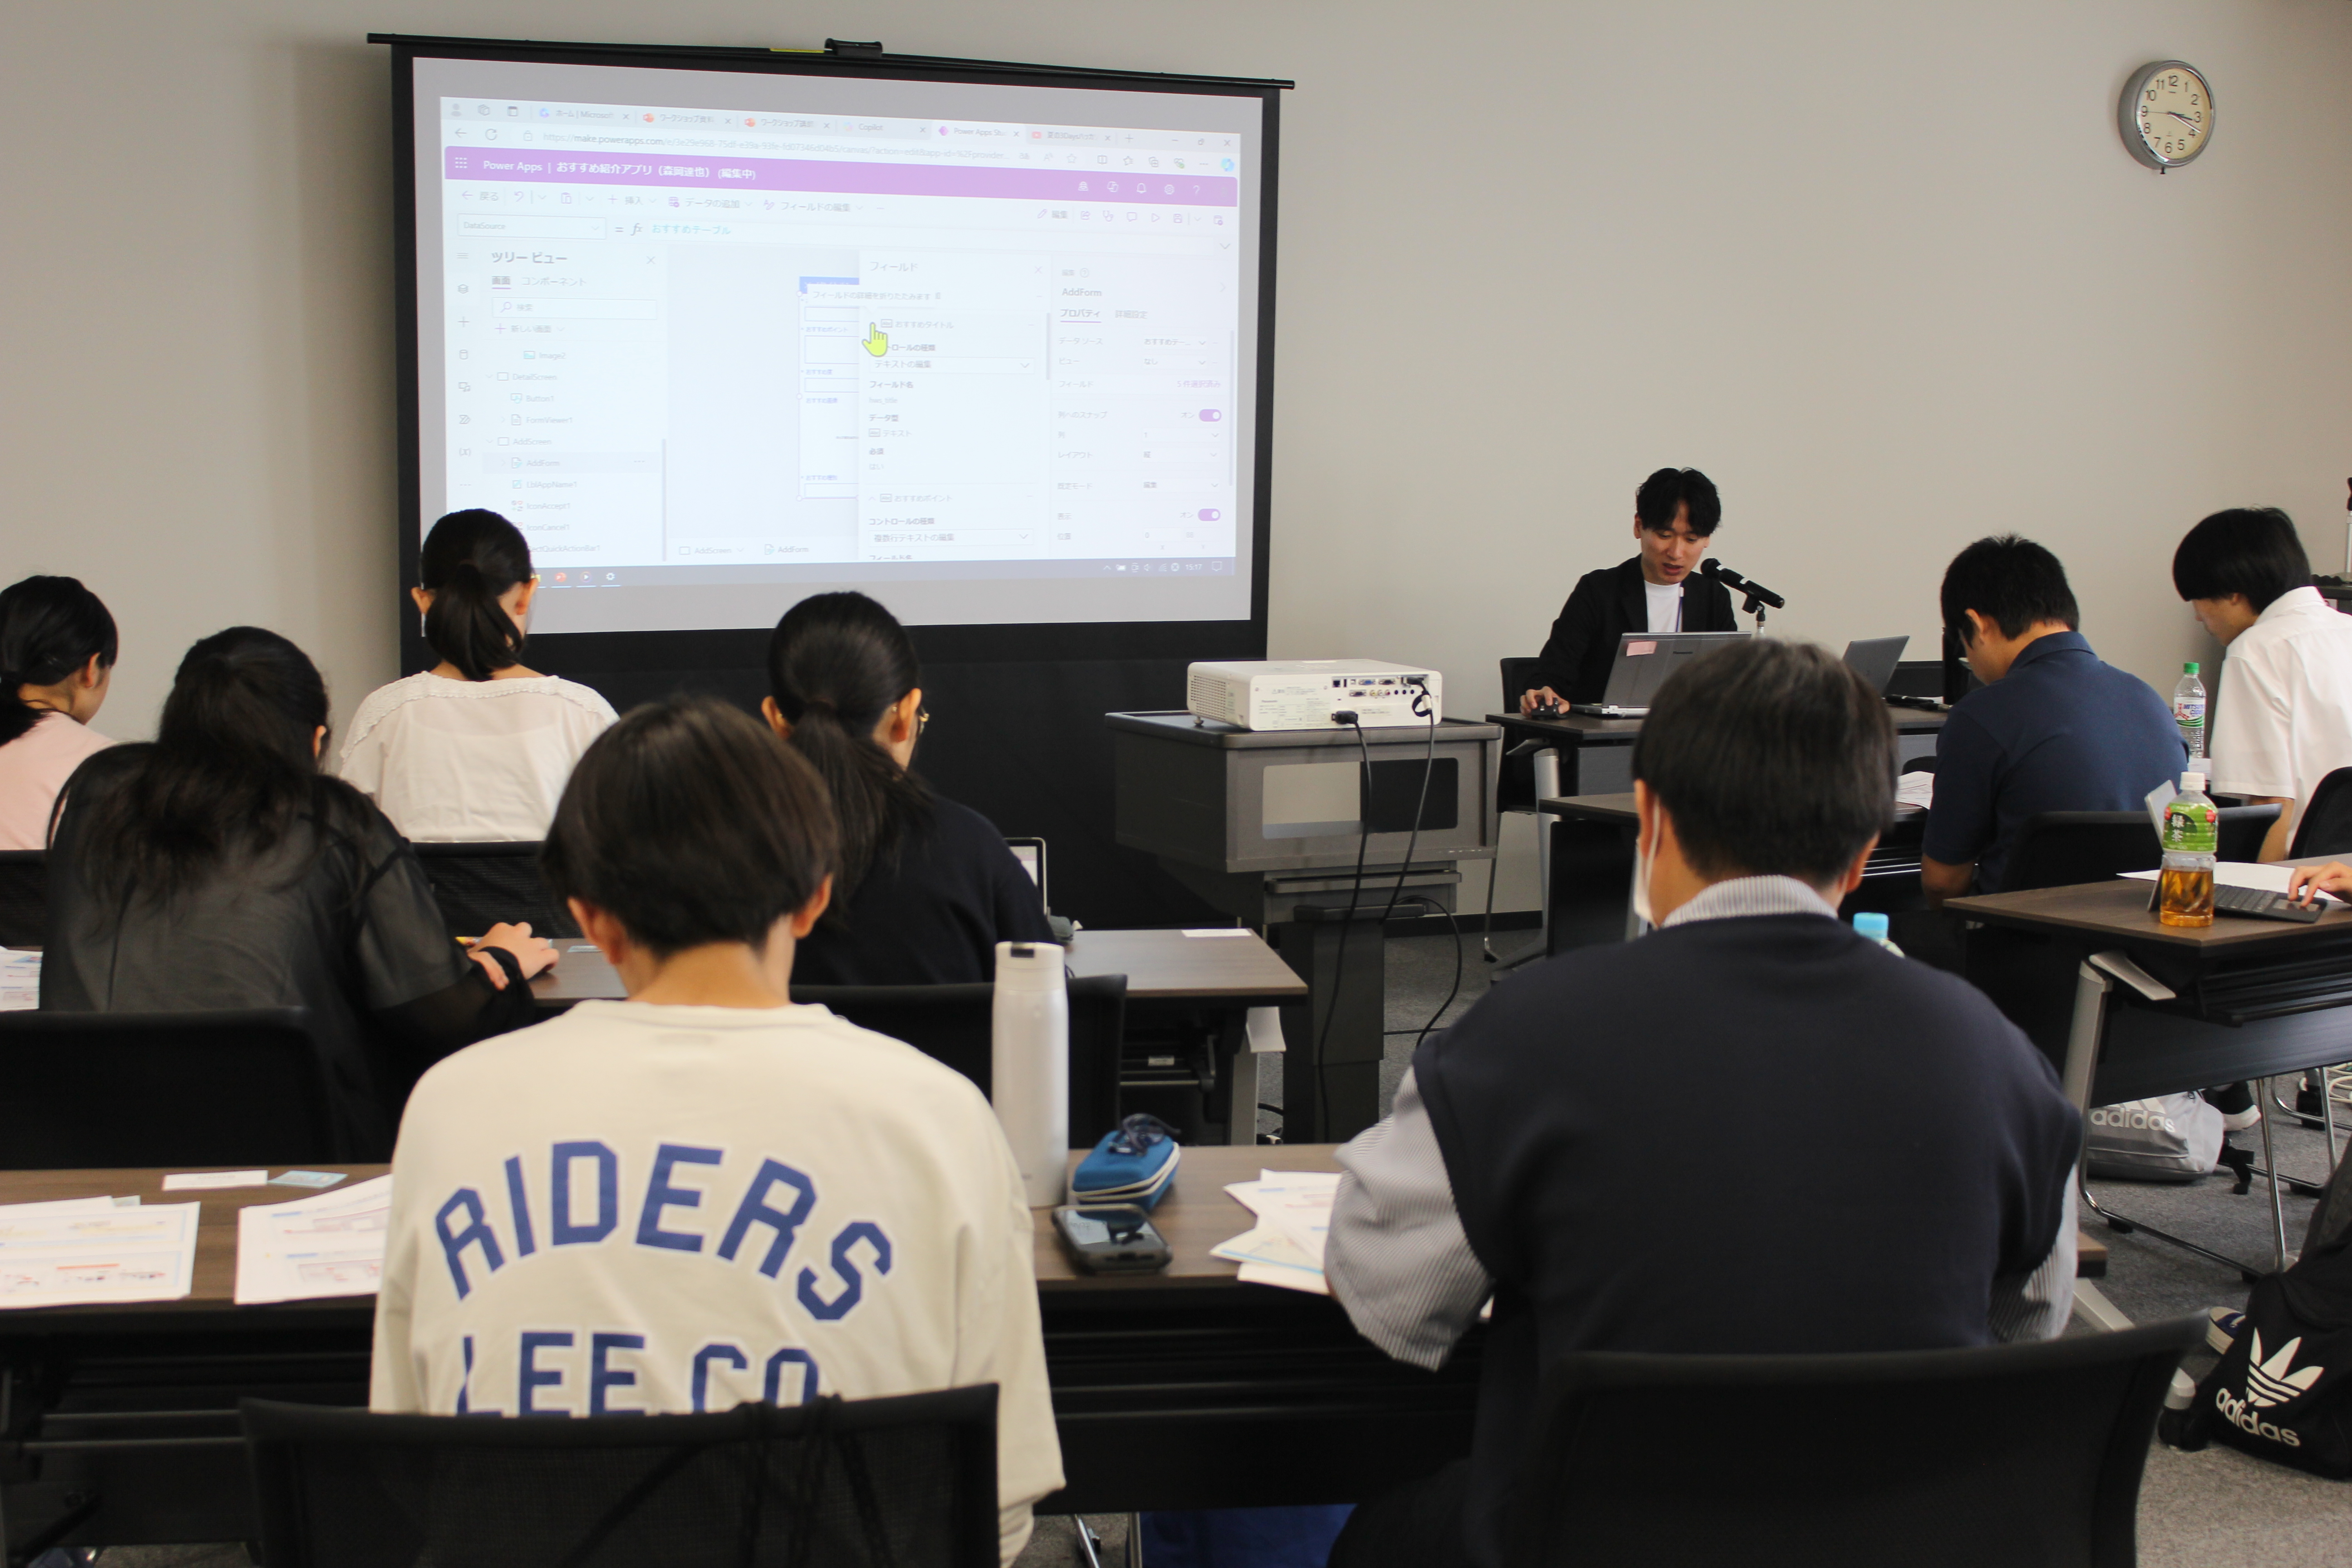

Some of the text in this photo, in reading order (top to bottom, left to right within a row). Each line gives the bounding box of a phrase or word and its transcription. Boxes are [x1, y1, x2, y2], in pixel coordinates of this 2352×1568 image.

[2156, 79, 2165, 90] 11
[2168, 75, 2178, 87] 12
[2185, 82, 2188, 92] 1
[2145, 89, 2156, 101] 10
[2191, 94, 2198, 105] 2
[2141, 106, 2148, 117] 9
[2195, 112, 2201, 122] 3
[858, 123, 883, 132] Copilot
[2144, 122, 2151, 134] 8
[2189, 129, 2196, 138] 4
[2154, 137, 2161, 147] 7
[2177, 139, 2185, 150] 5
[2165, 142, 2172, 153] 6
[483, 160, 515, 170] Power
[517, 162, 543, 173] Apps
[480, 191, 499, 201] 戻る
[686, 197, 740, 209] データの追加
[463, 221, 506, 230] DataSource
[652, 224, 731, 235] おすすめテーブル
[491, 251, 568, 264] ツリー ビュー
[870, 262, 918, 272] フィールド
[491, 275, 511, 285] 画面
[521, 277, 587, 287] コンポーネント
[1061, 287, 1102, 297] AddForm
[1060, 309, 1101, 318] プロパティ
[1058, 337, 1080, 345] データ
[887, 344, 936, 352] ロールの種類
[539, 353, 566, 361] Image2
[869, 381, 914, 389] フィールド名
[2090, 1107, 2176, 1133] adidas
[434, 1140, 892, 1321] RIDERS
[2215, 1387, 2301, 1447] adidas
